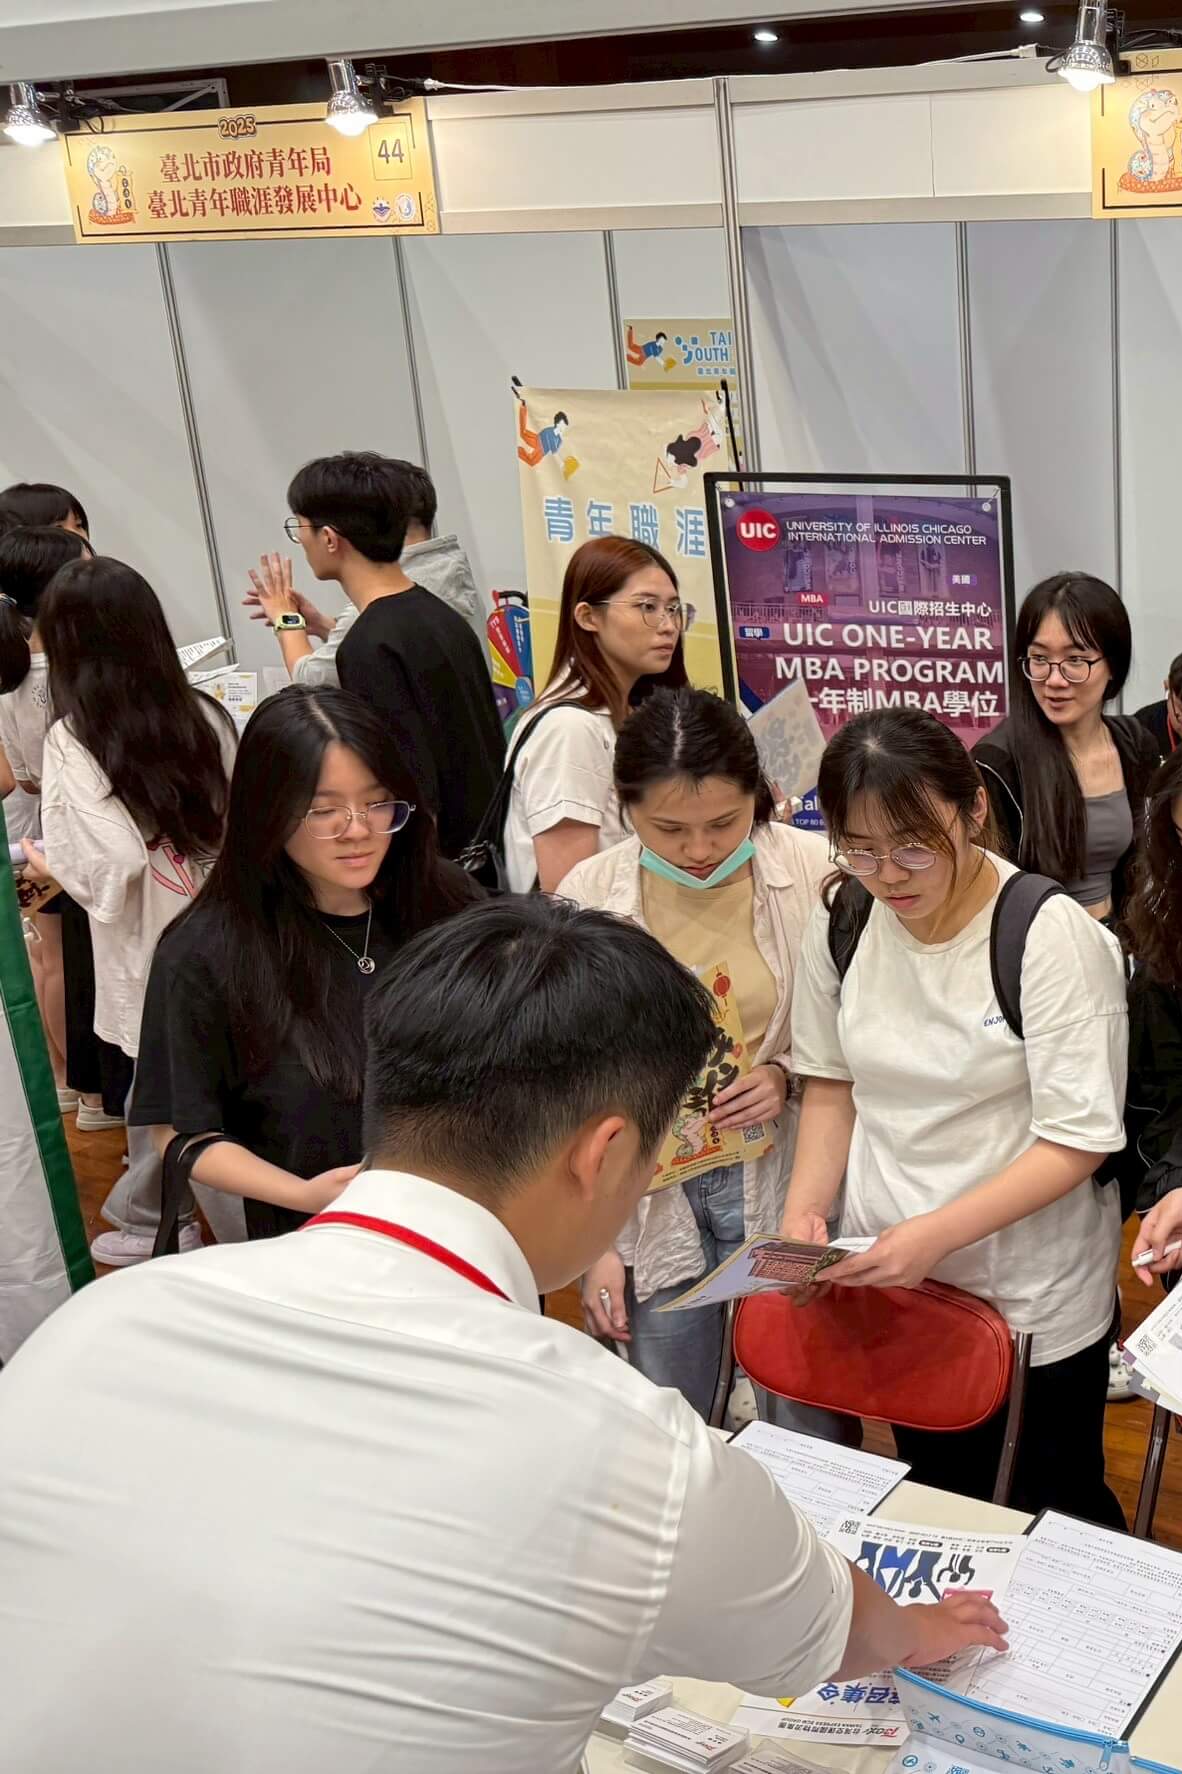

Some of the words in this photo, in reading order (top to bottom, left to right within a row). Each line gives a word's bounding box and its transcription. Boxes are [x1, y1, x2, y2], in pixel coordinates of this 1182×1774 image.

[220, 117, 256, 137] 2025
[378, 139, 405, 164] 44
[160, 146, 331, 183] 臺北市政府青年局
[148, 183, 362, 220] 臺北青年職涯發展中心
[739, 522, 776, 539] UIC
[786, 521, 852, 532] UNIVERSITY
[856, 523, 871, 532] OF
[874, 523, 919, 534] ILLINOIS
[922, 524, 972, 535] CHICAGO
[788, 532, 875, 543] INTERNATIONAL
[879, 534, 942, 544] ADMISSION
[944, 535, 986, 545] CENTER
[801, 594, 824, 604] MBA
[869, 601, 992, 617] UIC國際招生中心
[783, 623, 833, 646] UIC
[842, 625, 993, 650] ONE-YEAR
[776, 657, 845, 680] MBA
[854, 659, 1003, 684] PROGRAM
